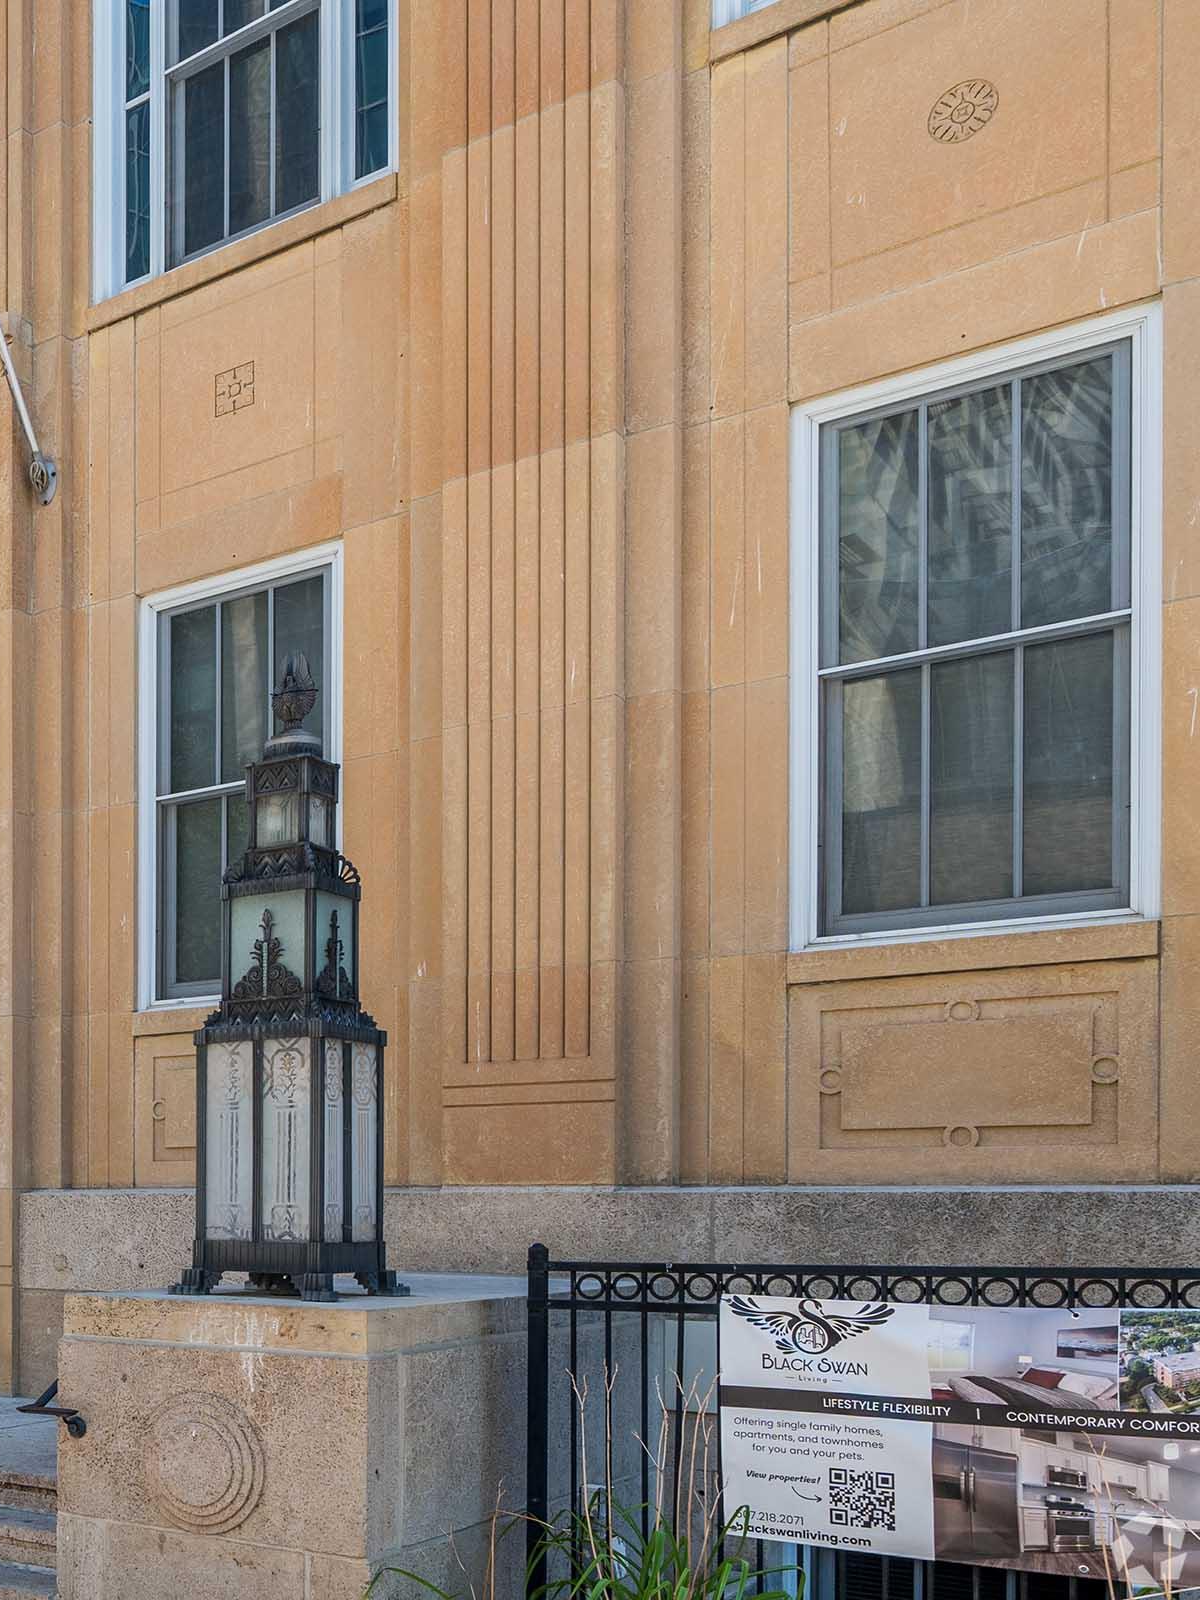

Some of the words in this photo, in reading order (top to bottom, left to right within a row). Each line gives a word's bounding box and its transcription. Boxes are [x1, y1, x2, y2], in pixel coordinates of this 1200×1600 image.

[762, 1353, 813, 1373] BLACK
[817, 1358, 868, 1376] SWAN
[798, 1375, 828, 1384] Living
[823, 1398, 879, 1412] LIFESTYLE
[882, 1402, 951, 1417] FLEXIBILITY
[733, 1416, 774, 1429] Offering
[776, 1418, 807, 1431] single
[809, 1422, 842, 1434] family
[844, 1424, 883, 1437] homes,
[1006, 1411, 1126, 1429] CONTEMPORARY
[1130, 1419, 1200, 1433] COMFOR
[733, 1430, 796, 1443] apartments,
[797, 1433, 819, 1444] and
[821, 1436, 884, 1449] townhomes
[752, 1443, 766, 1452] for
[768, 1446, 787, 1455] you
[789, 1447, 810, 1457] and
[812, 1449, 836, 1460] your
[838, 1452, 865, 1462] pets.
[746, 1470, 767, 1480] View
[768, 1473, 822, 1484] properties!
[735, 1521, 872, 1547] backswanliving.com
